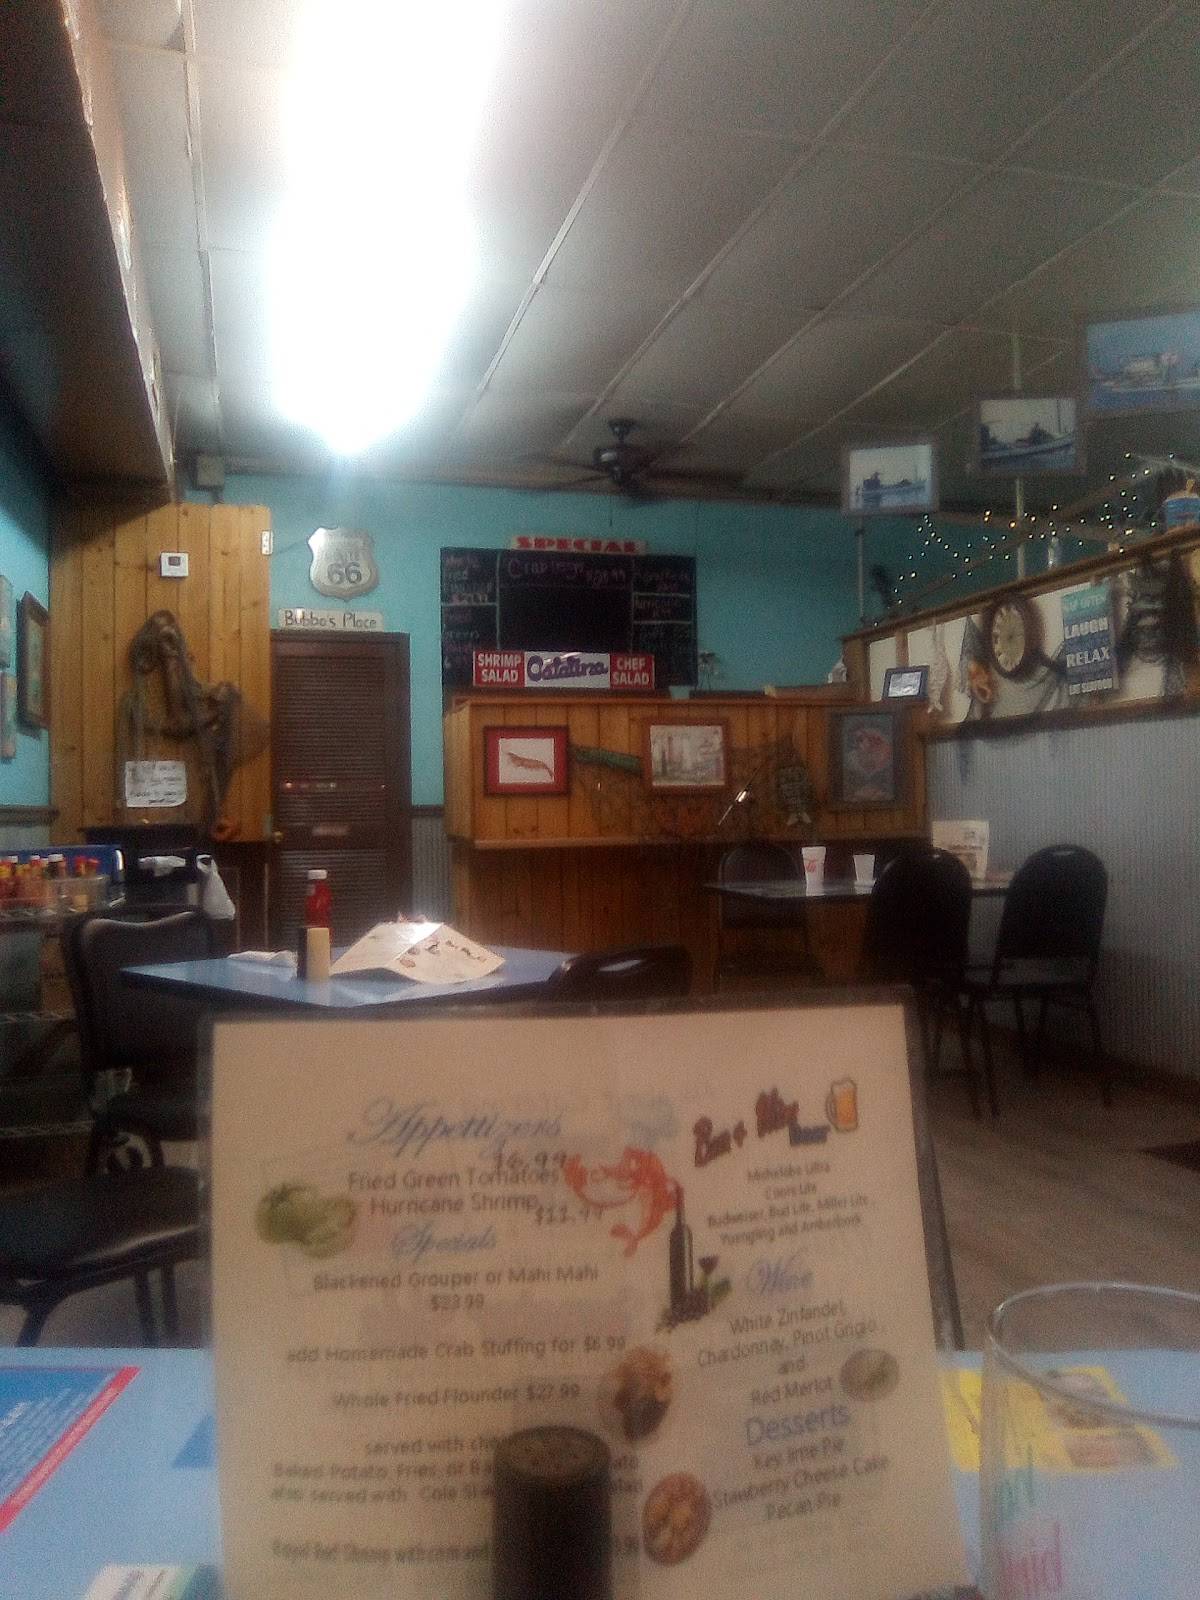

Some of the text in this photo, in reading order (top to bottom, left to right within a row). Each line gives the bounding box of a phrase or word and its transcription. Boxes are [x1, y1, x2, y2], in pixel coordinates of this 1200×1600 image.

[327, 562, 362, 584] 66
[343, 612, 377, 628] Place
[1065, 617, 1109, 639] LAUGH
[478, 653, 521, 667] SHRIMP
[617, 658, 646, 671] CHEF
[1066, 647, 1110, 668] RELAX
[481, 668, 518, 683] SALAD
[613, 671, 650, 685] SALAD
[349, 1166, 557, 1191] Fried Green Tomatoes
[370, 1191, 540, 1217] Hurricane Shrimp
[778, 1222, 799, 1238] and
[313, 1264, 599, 1292] Blackened Grouper or Mahi Mahi
[729, 1300, 846, 1336] White Zinfandel
[793, 1325, 832, 1346] Pinot
[325, 1342, 429, 1363] Homemade
[434, 1340, 475, 1360] Crab
[481, 1336, 546, 1359] Stuffing
[551, 1336, 577, 1354] for
[777, 1356, 806, 1375] and
[445, 1384, 520, 1405] Flounder
[751, 1376, 834, 1405] Red Merlot
[745, 1404, 852, 1447] Desserts
[364, 1437, 424, 1457] served
[427, 1434, 464, 1456] with
